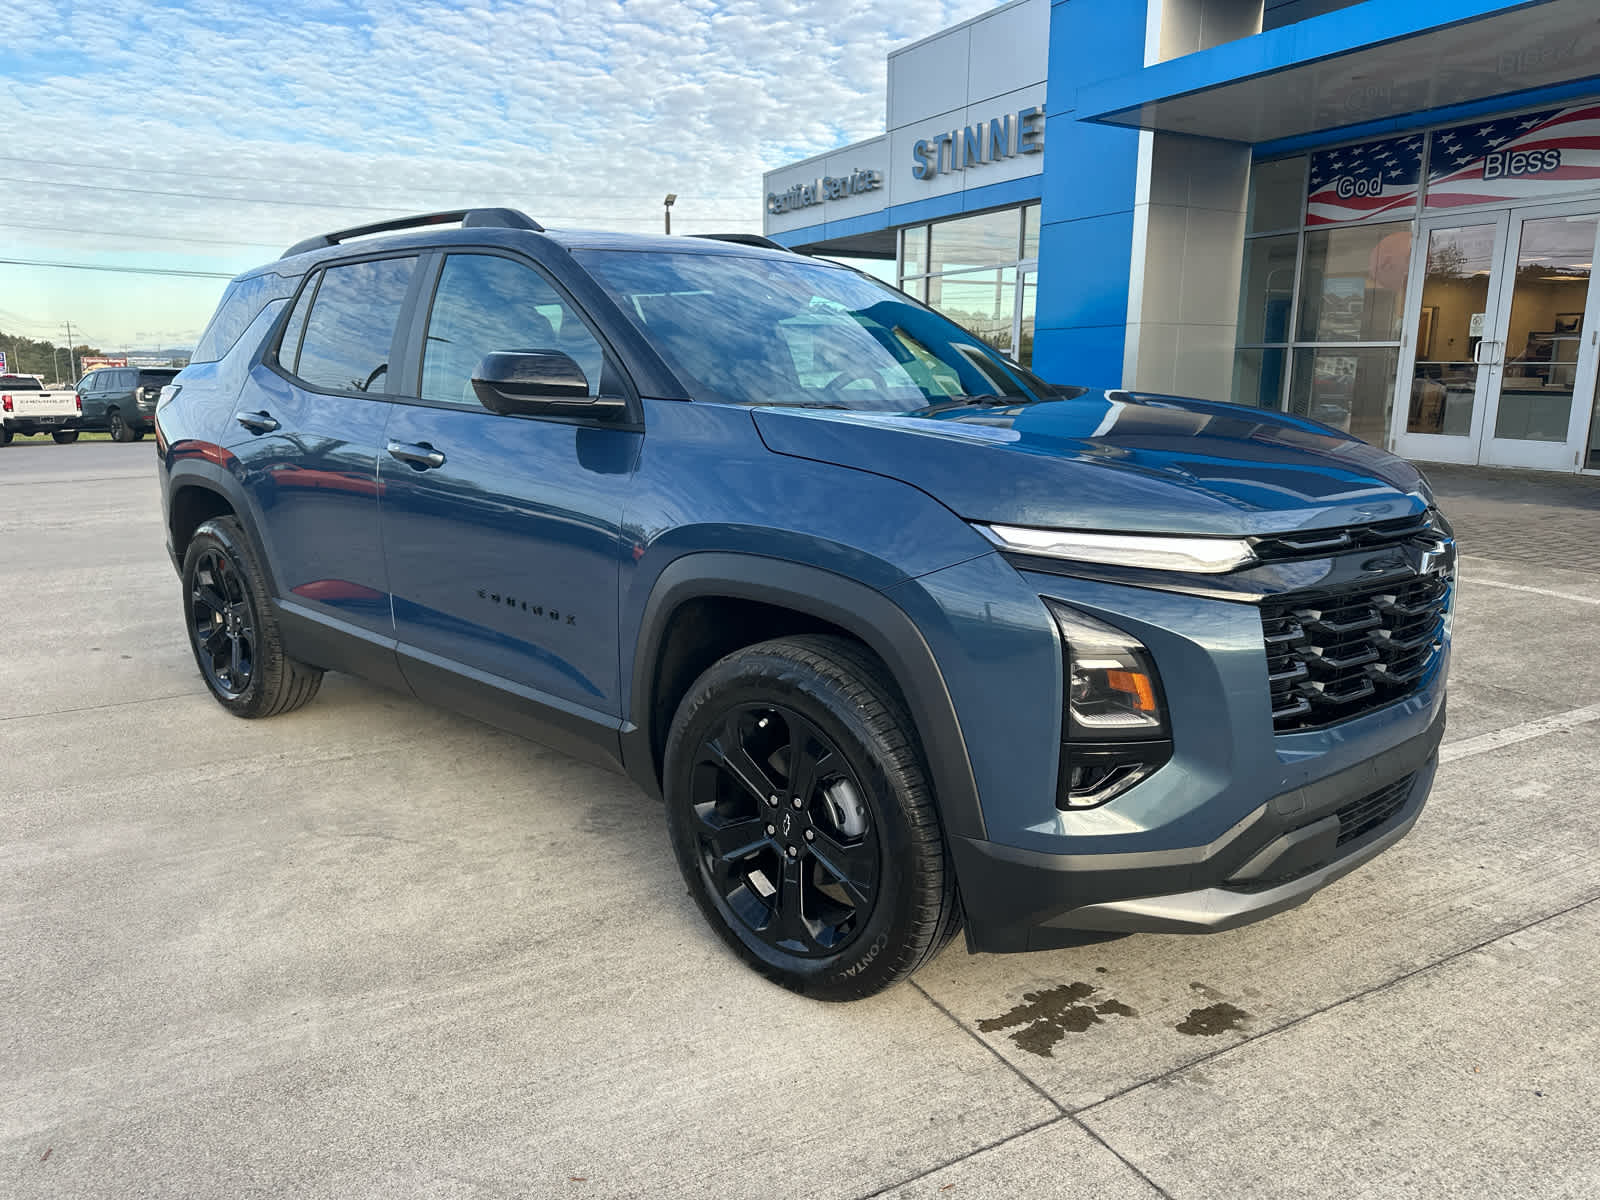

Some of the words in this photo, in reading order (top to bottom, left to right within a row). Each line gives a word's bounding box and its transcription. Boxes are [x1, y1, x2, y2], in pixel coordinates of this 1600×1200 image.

[911, 103, 1047, 181] STINNE
[767, 179, 822, 214] Certified
[822, 168, 883, 199] Service
[1337, 174, 1382, 198] God
[1484, 149, 1560, 180] Bless
